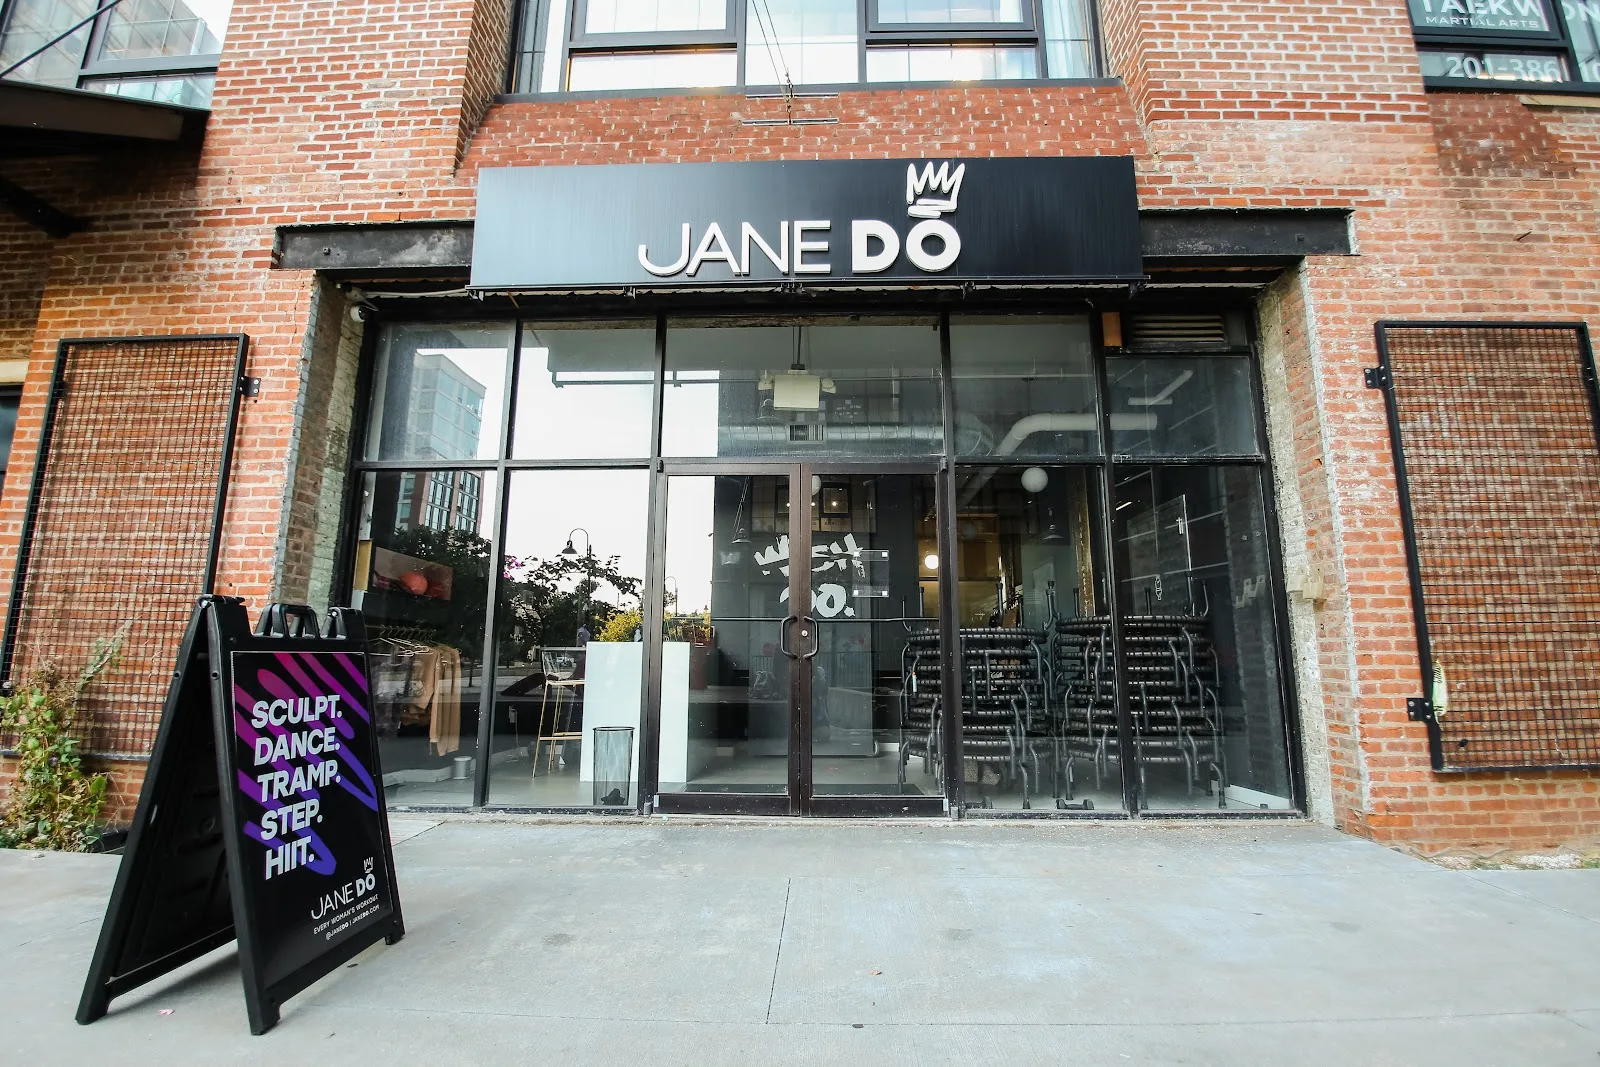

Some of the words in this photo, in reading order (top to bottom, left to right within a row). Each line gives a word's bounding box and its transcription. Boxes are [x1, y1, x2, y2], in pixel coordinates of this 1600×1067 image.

[1425, 16, 1495, 27] MARTIAL
[1498, 19, 1540, 28] ARTS
[638, 220, 831, 277] JANE
[851, 219, 962, 273] DO
[251, 695, 343, 729] SCULPT.
[254, 726, 341, 766] DANCE.
[257, 759, 341, 803] TRAMP.
[260, 798, 323, 841] STEP.
[265, 835, 315, 881] HIIT.
[311, 882, 355, 920] JANE
[355, 873, 376, 898] DO
[313, 920, 331, 935] EVERY
[330, 906, 356, 925] WOMAN'S
[355, 893, 379, 911] WORKOUT
[325, 921, 349, 941] @JANEDO
[352, 904, 380, 924] JANEDO.COM
